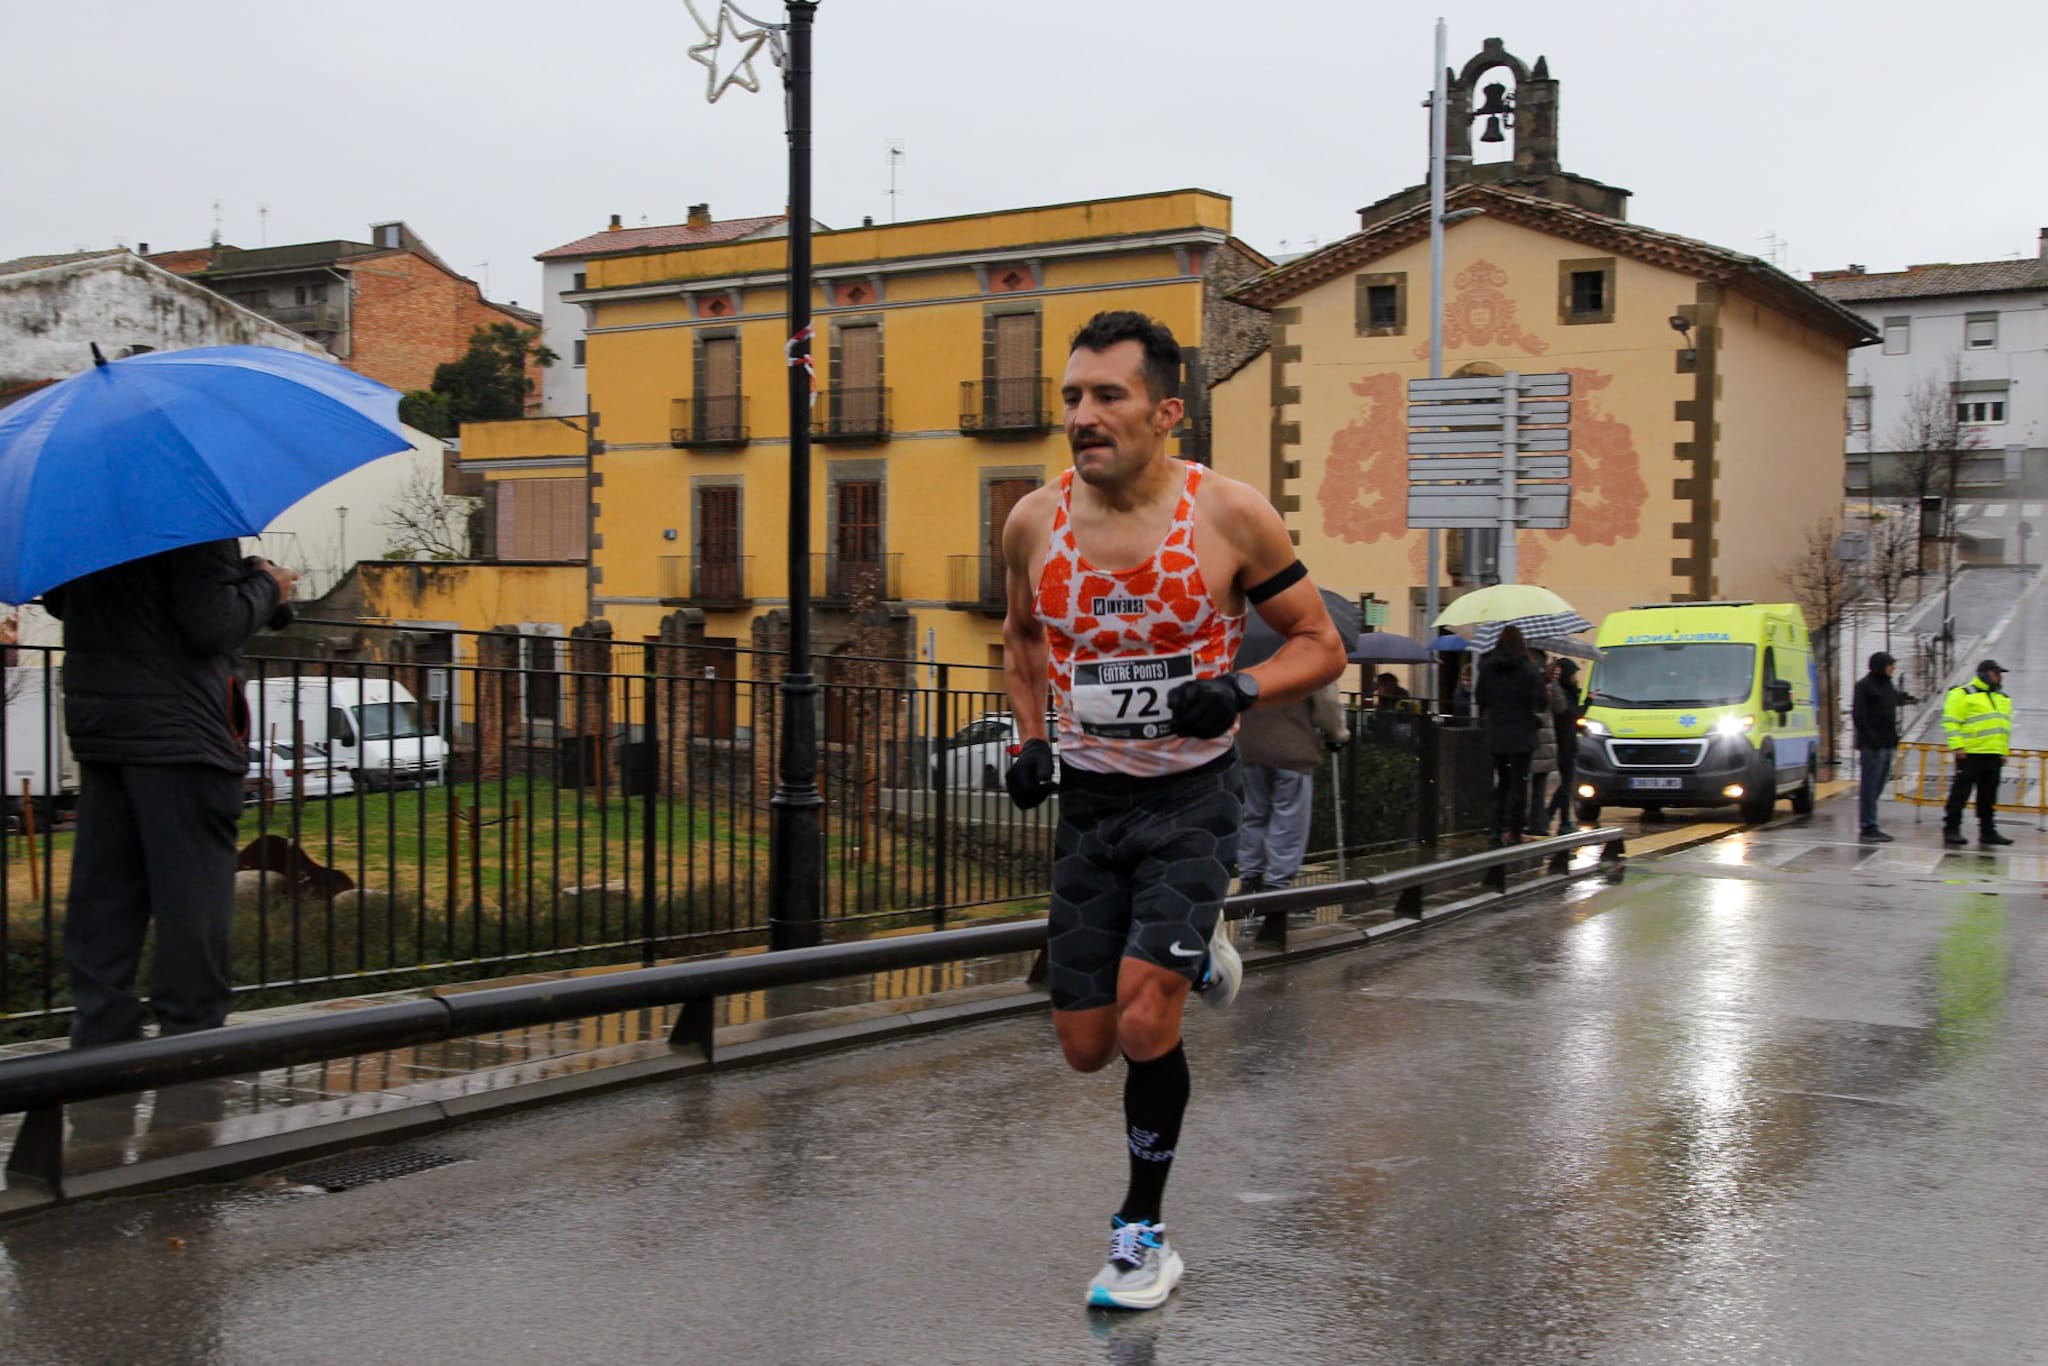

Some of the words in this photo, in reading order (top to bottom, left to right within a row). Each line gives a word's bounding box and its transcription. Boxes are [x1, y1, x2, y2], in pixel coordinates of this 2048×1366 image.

[1103, 666, 1131, 682] ENTRE
[1133, 664, 1164, 681] PONTS
[1111, 687, 1160, 718] 72
